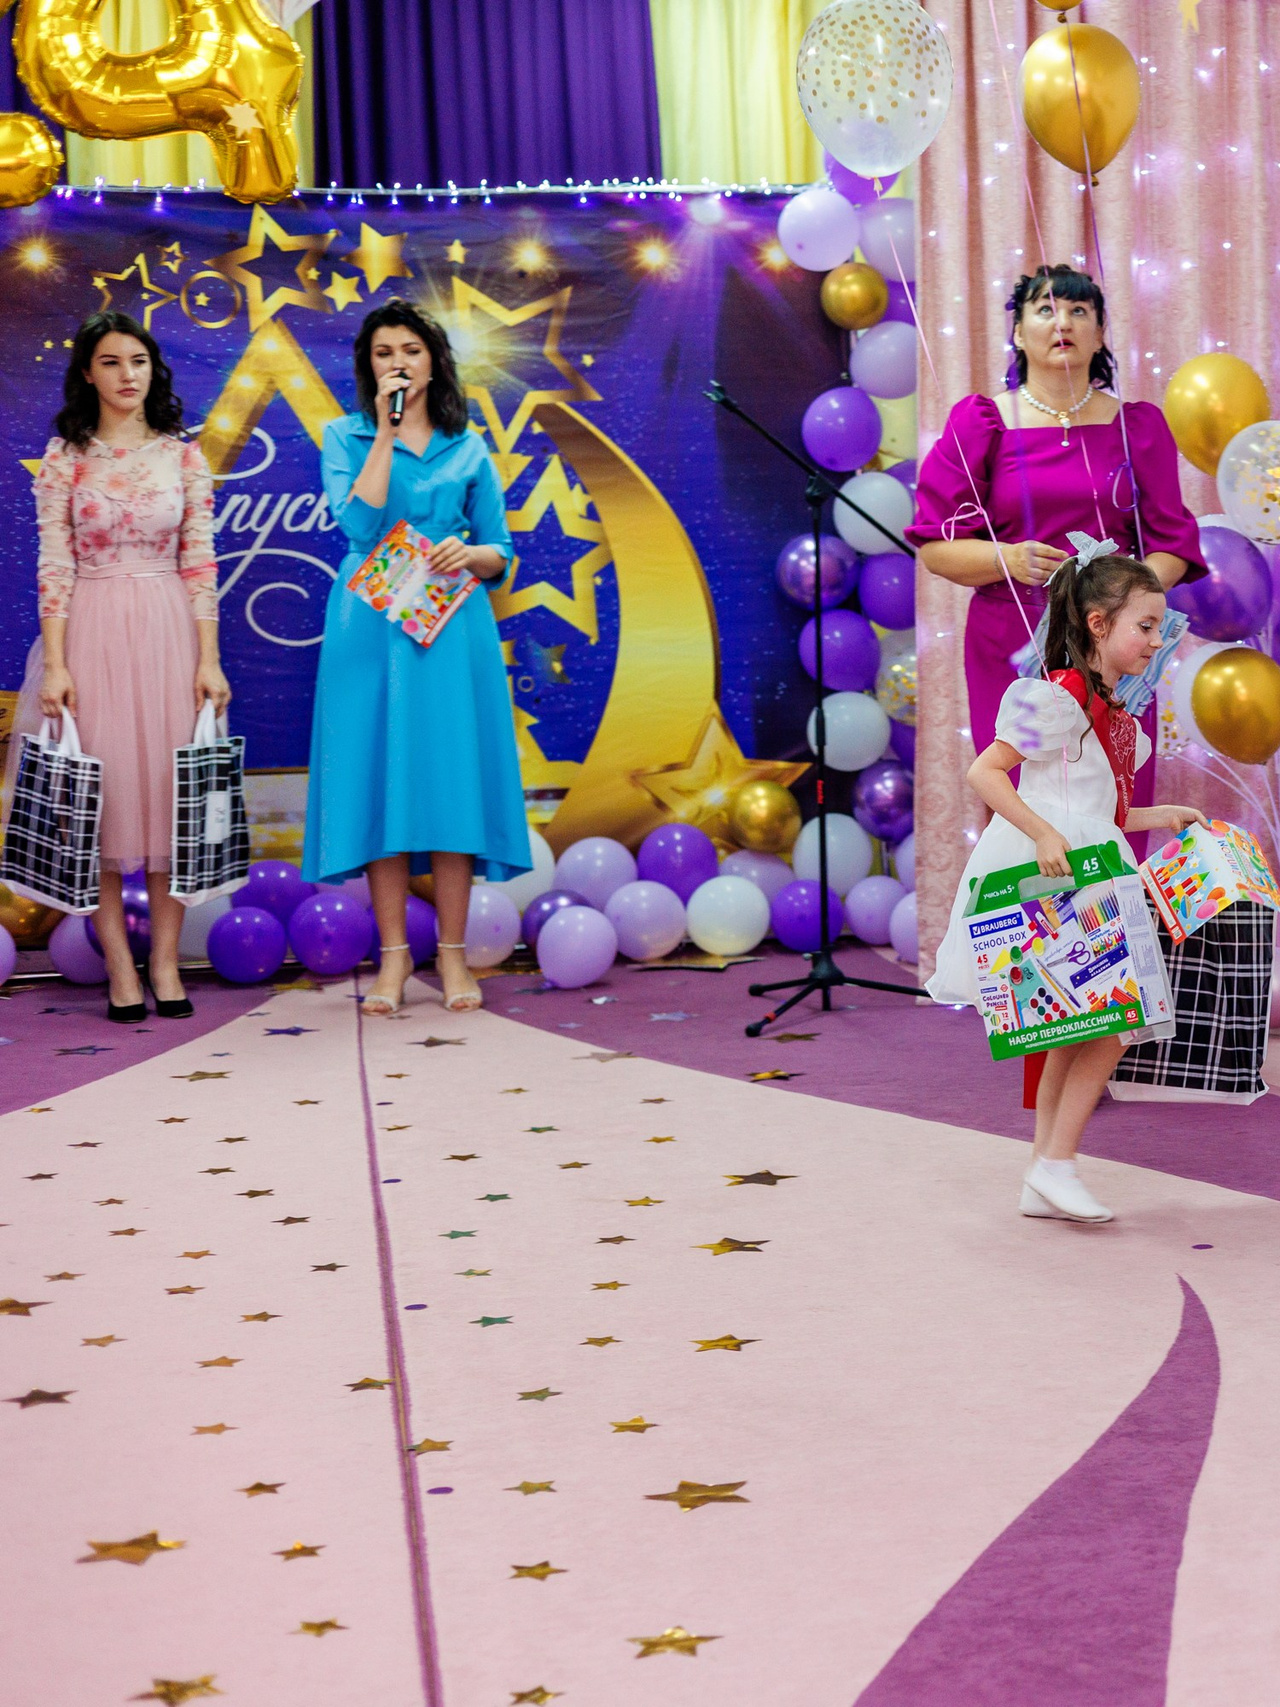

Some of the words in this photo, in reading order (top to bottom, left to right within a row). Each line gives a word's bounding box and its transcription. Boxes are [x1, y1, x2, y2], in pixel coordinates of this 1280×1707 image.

[1082, 857, 1100, 873] 45
[980, 916, 1018, 933] BRAUBERG
[973, 937, 1008, 952] SCHOOL
[1009, 931, 1027, 943] BOX
[977, 954, 988, 965] 45
[1126, 1010, 1136, 1018] 45
[1008, 1031, 1038, 1047] НАБОР
[1040, 1011, 1122, 1038] ПЕРВОКЛАССНИКА
